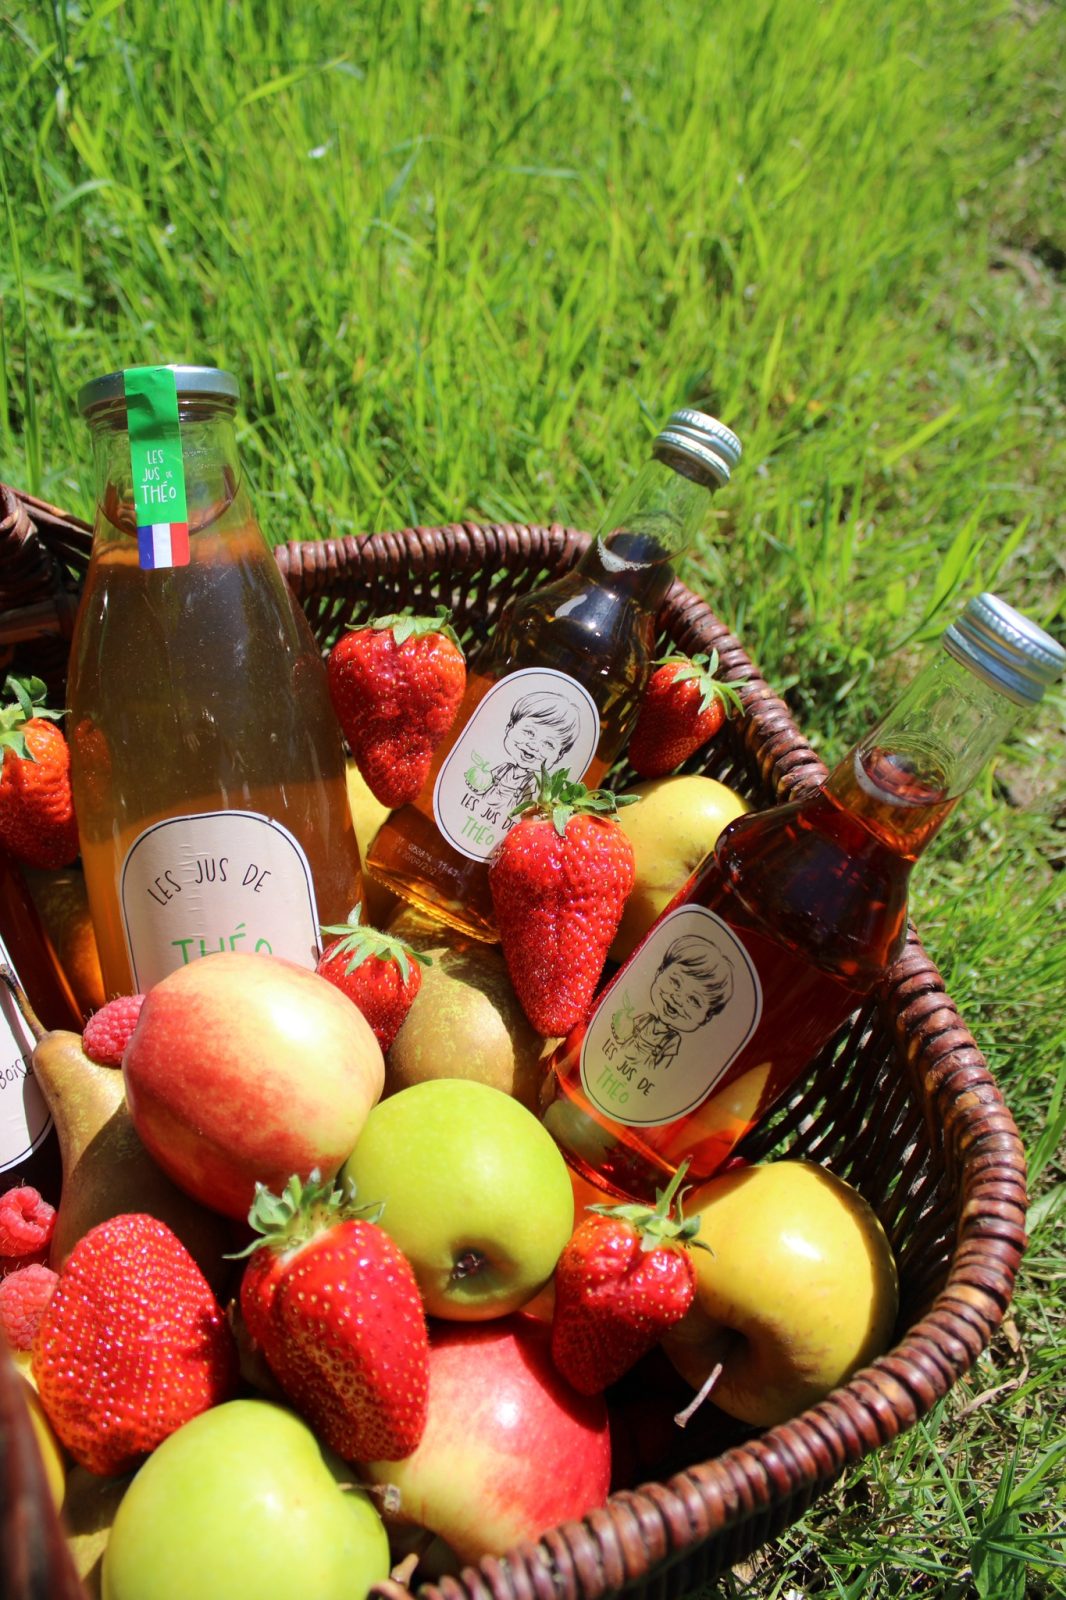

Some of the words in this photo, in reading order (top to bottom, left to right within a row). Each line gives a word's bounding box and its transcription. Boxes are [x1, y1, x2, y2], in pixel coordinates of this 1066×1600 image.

[147, 449, 164, 465] LES
[142, 466, 160, 482] JUS
[460, 792, 480, 812] LES
[480, 807, 502, 825] JUS
[147, 870, 182, 906] LES
[195, 857, 229, 884] JUS
[242, 863, 272, 893] DE
[601, 1038, 618, 1061] LES
[616, 1060, 638, 1082] JUS
[636, 1077, 656, 1097] DE
